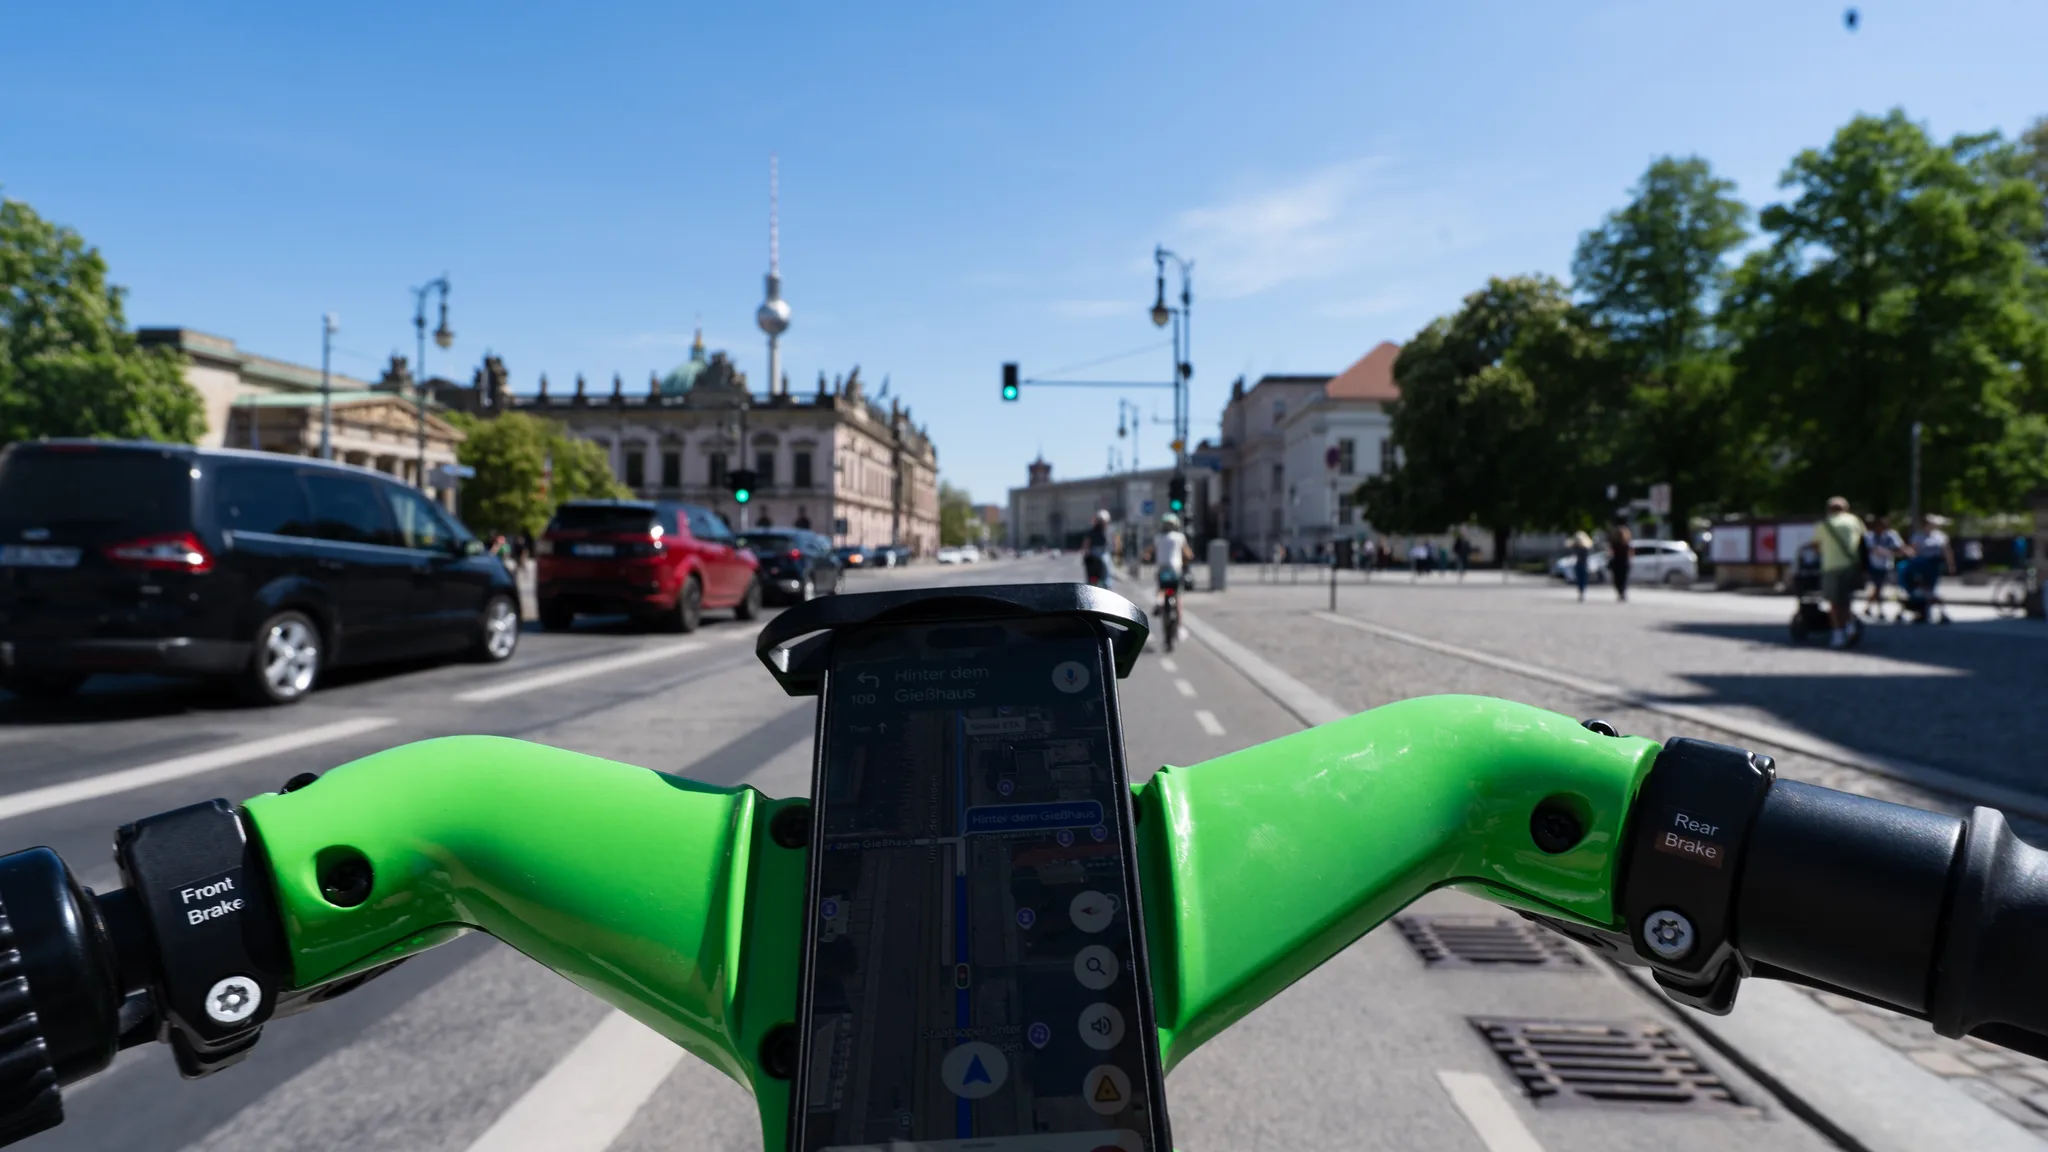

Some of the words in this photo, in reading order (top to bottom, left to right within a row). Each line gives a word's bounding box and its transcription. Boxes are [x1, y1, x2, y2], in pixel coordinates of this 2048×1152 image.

[894, 667, 946, 683] Hinter
[950, 665, 990, 680] dem
[850, 693, 877, 706] 100
[894, 685, 977, 703] Gießhaus
[848, 724, 873, 735] Then
[1001, 720, 1021, 730] ETA
[972, 814, 1008, 826] Hinter
[1012, 812, 1038, 823] dem
[1040, 808, 1096, 821] Gießhaus
[1674, 812, 1720, 837] Rear
[835, 840, 860, 850] dem
[862, 838, 915, 850] Gießhaus
[1664, 831, 1717, 859] Brake
[180, 876, 236, 905] Front
[186, 898, 246, 926] Brake
[922, 1026, 986, 1041] Staatsoper
[989, 1024, 1023, 1037] Unter
